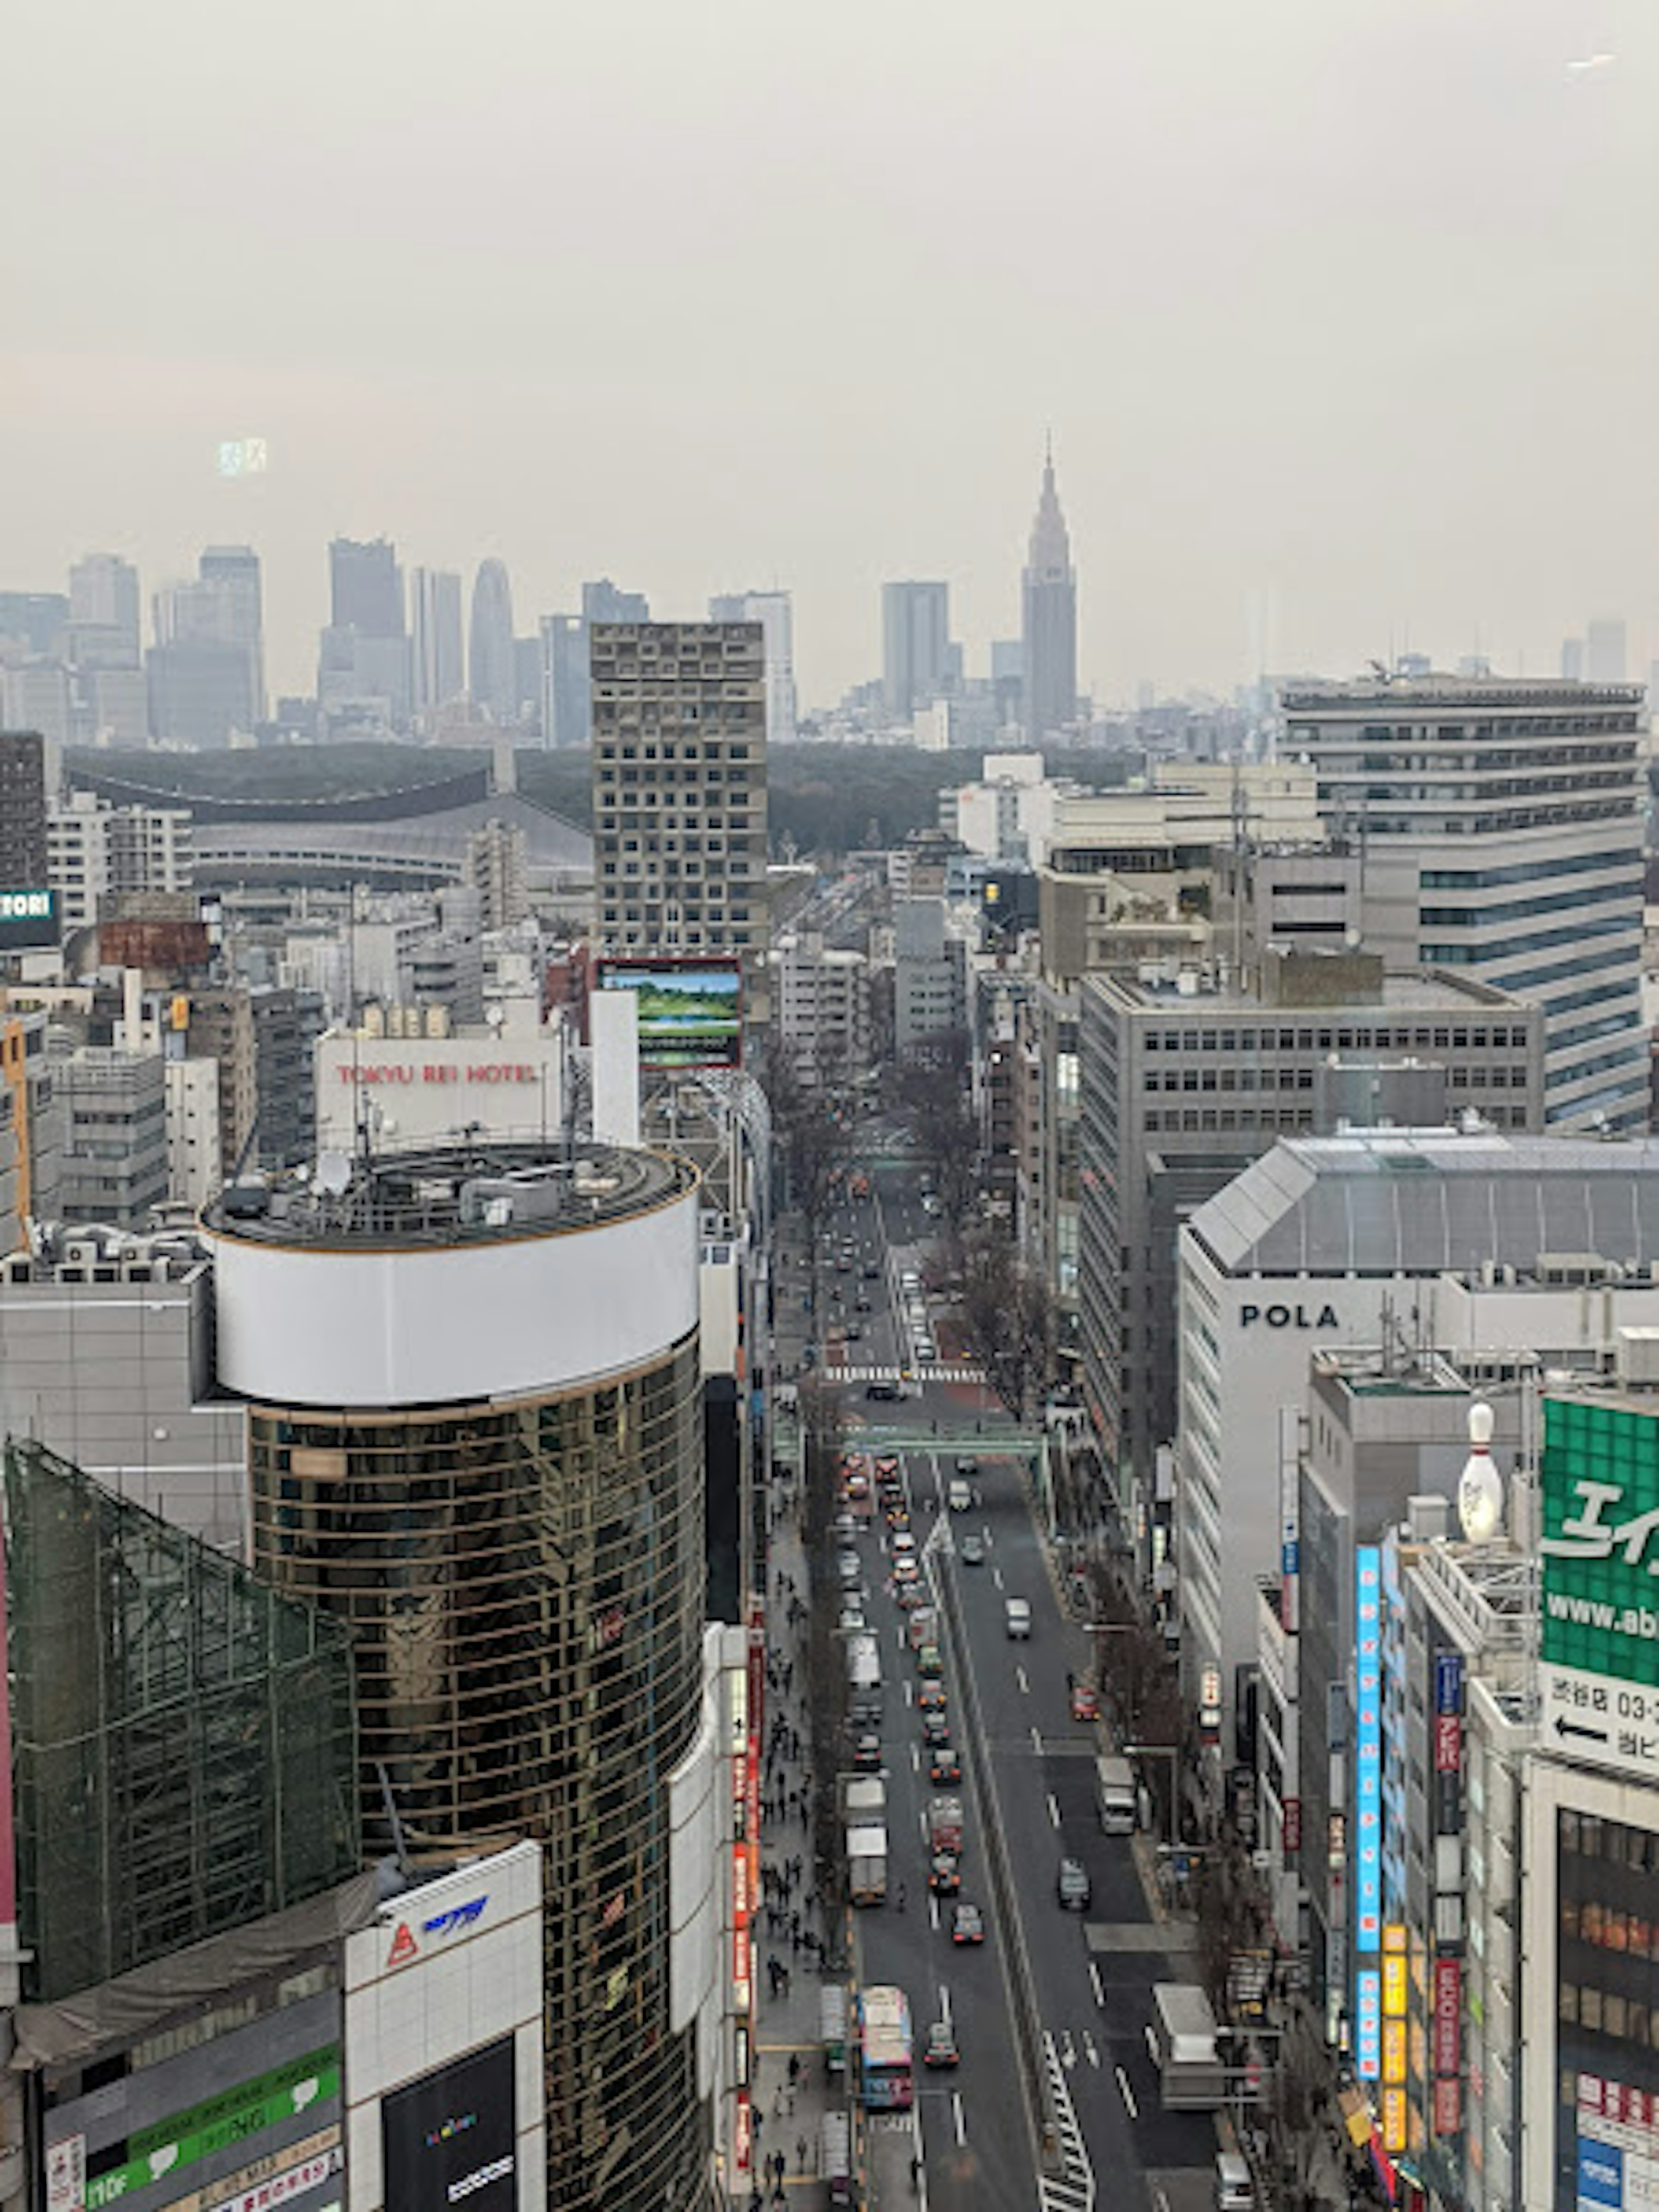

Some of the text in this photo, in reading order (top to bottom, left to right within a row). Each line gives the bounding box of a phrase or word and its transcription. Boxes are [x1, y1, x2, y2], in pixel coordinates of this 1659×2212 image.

[337, 1065, 537, 1084] TOKYU REI HOTEL
[1241, 1305, 1338, 1328] POLA
[1539, 1479, 1659, 1576] エイ
[1547, 1591, 1659, 1640] www.ab
[1618, 1692, 1659, 1724] 03-
